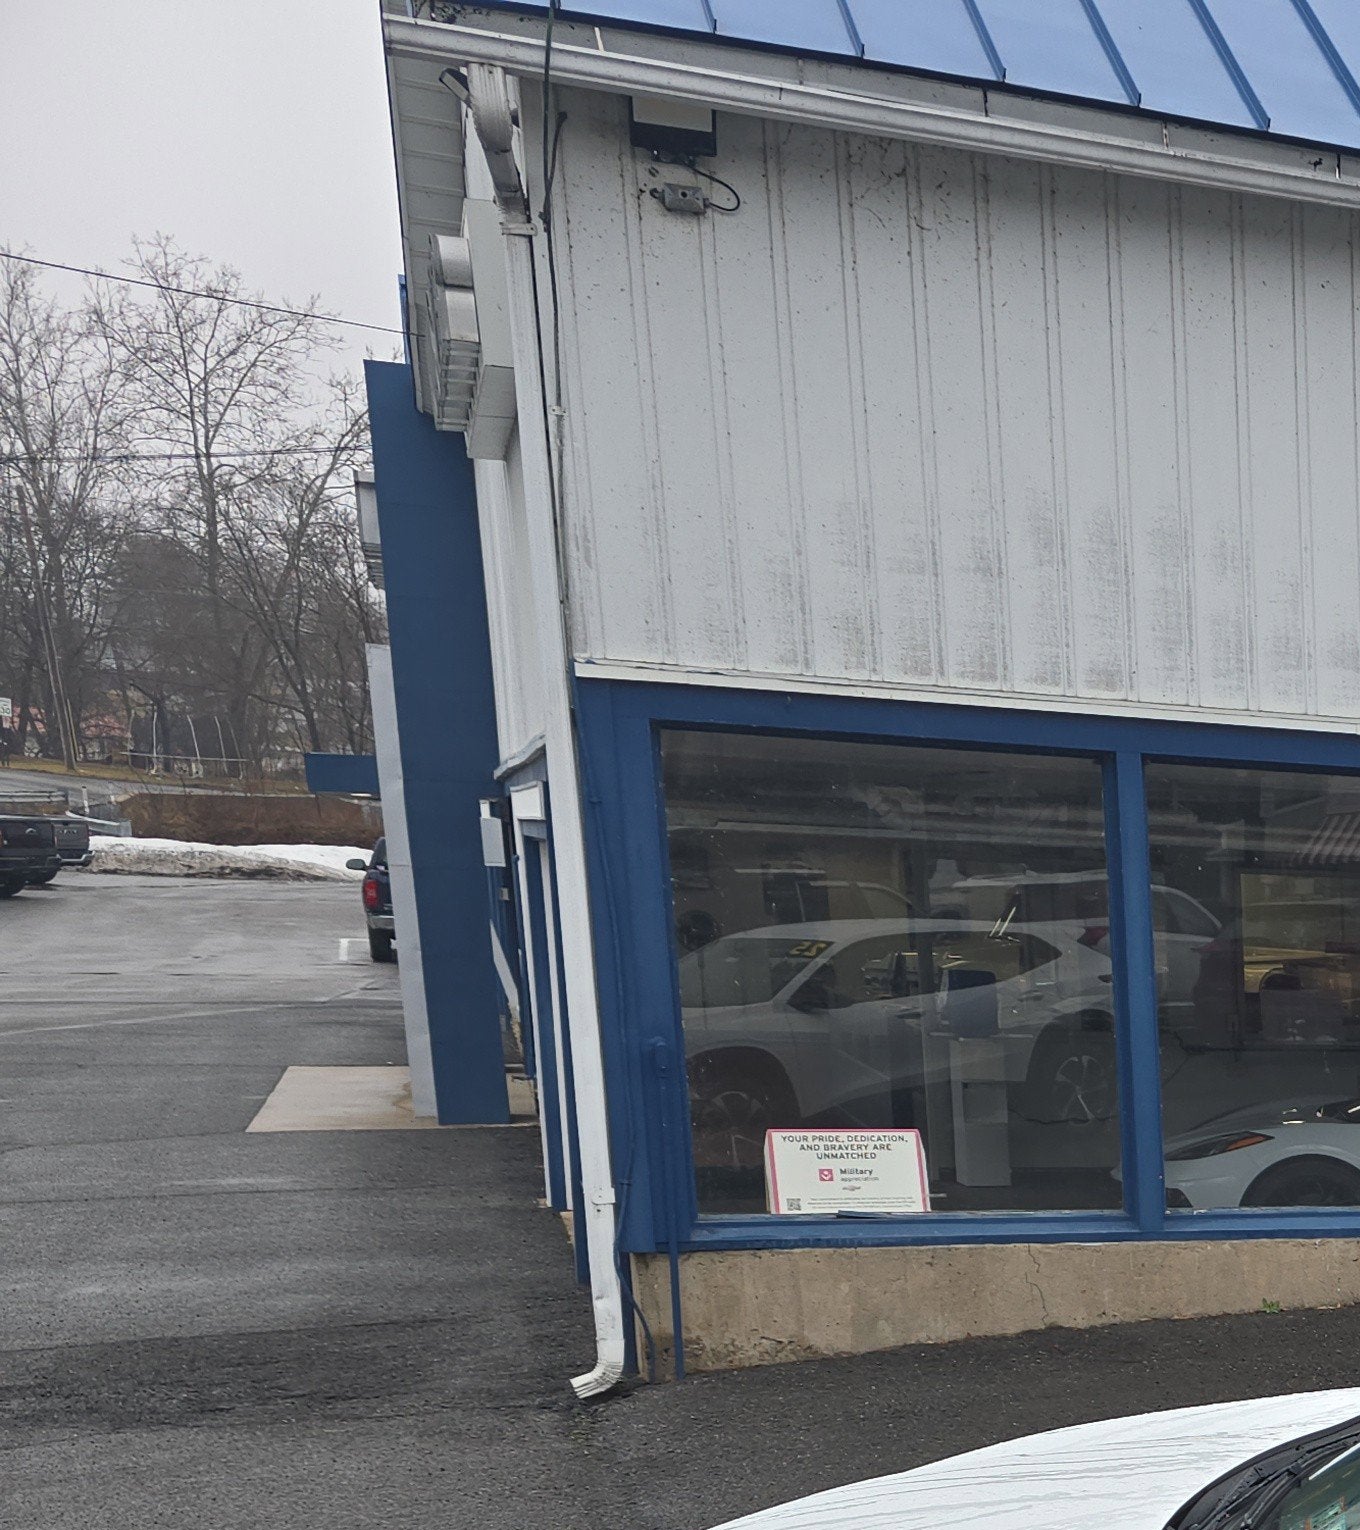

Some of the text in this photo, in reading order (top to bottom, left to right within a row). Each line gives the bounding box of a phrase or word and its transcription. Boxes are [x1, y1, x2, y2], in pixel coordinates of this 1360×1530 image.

[781, 1134, 808, 1142] YOUR
[847, 1135, 908, 1143] DEDICATION,
[816, 1152, 877, 1160] UNMATCHED
[839, 1168, 873, 1176] Military
